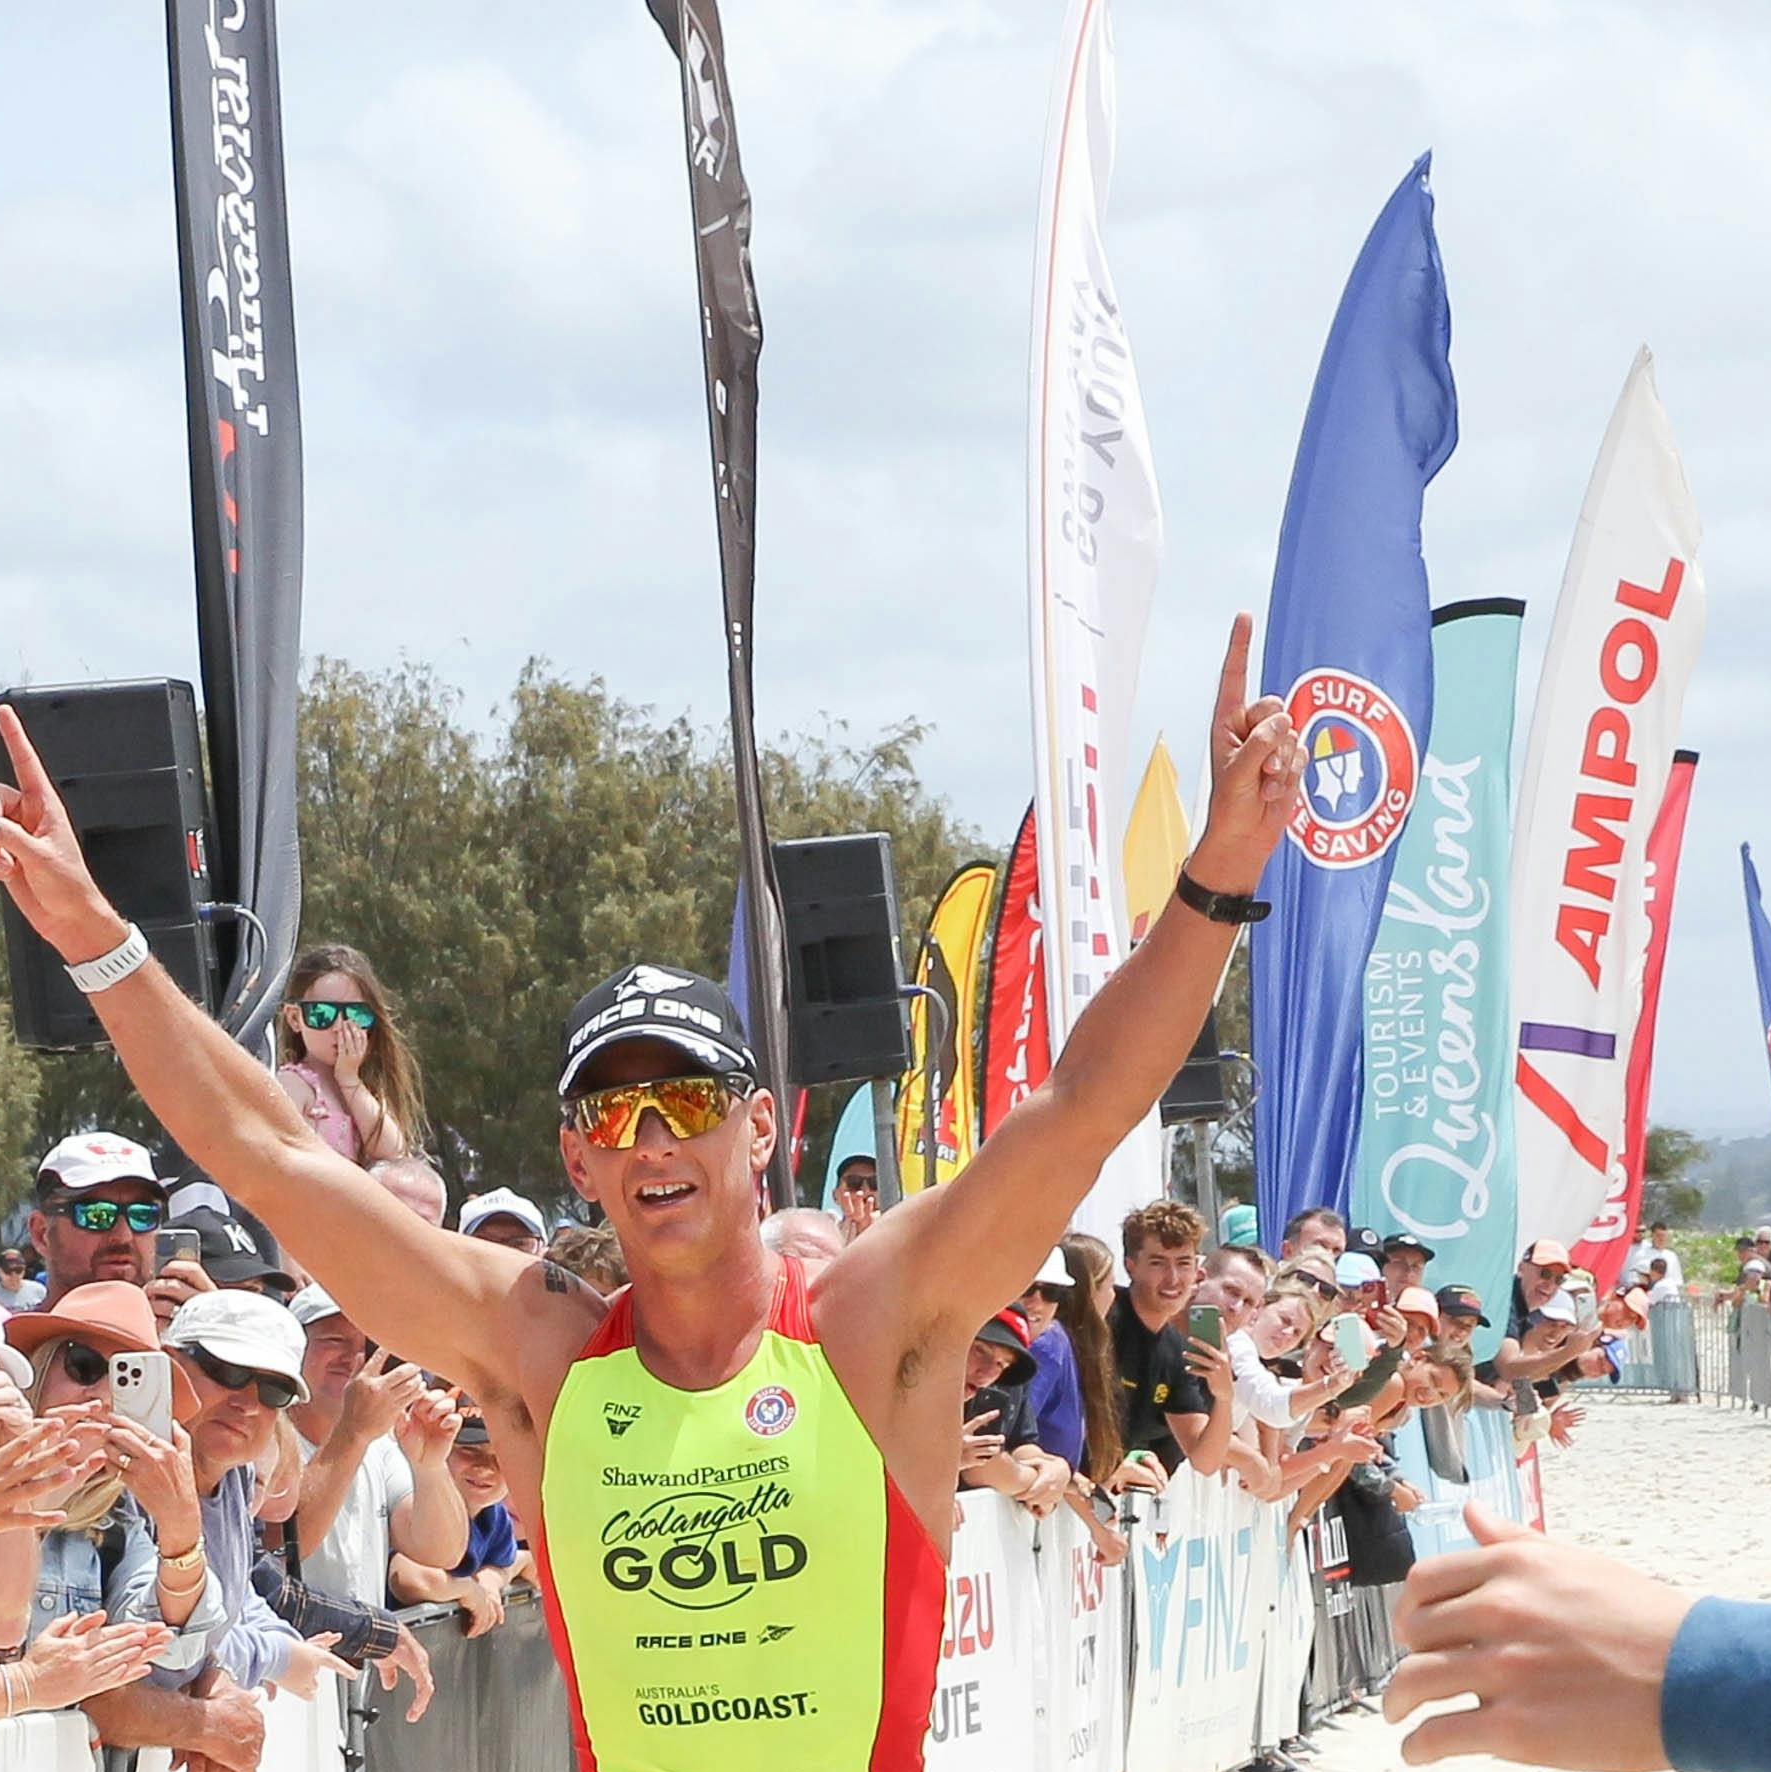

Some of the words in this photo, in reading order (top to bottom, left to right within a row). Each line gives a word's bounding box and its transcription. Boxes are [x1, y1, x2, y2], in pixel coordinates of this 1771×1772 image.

[1312, 681, 1388, 722] SURF
[1555, 556, 1686, 993] AMPOL
[1313, 788, 1406, 858] SAVING
[568, 998, 648, 1055] RACE
[652, 998, 724, 1034] ONE
[1381, 755, 1498, 1240] Queensland
[1397, 950, 1428, 1083] EVENTS
[1371, 951, 1395, 1121] TOURISM
[1404, 1094, 1428, 1119] &
[603, 1402, 643, 1418] FINZ
[601, 1481, 795, 1548] Coolangatta
[602, 1533, 809, 1592] GOLD
[1176, 1526, 1253, 1688] FINZ
[636, 1636, 692, 1648] RACE
[700, 1631, 747, 1647] ONE
[635, 1684, 720, 1700] AUSTRALIA'S
[639, 1692, 818, 1727] GOLDCOAST.
[931, 1680, 982, 1744] UTE
